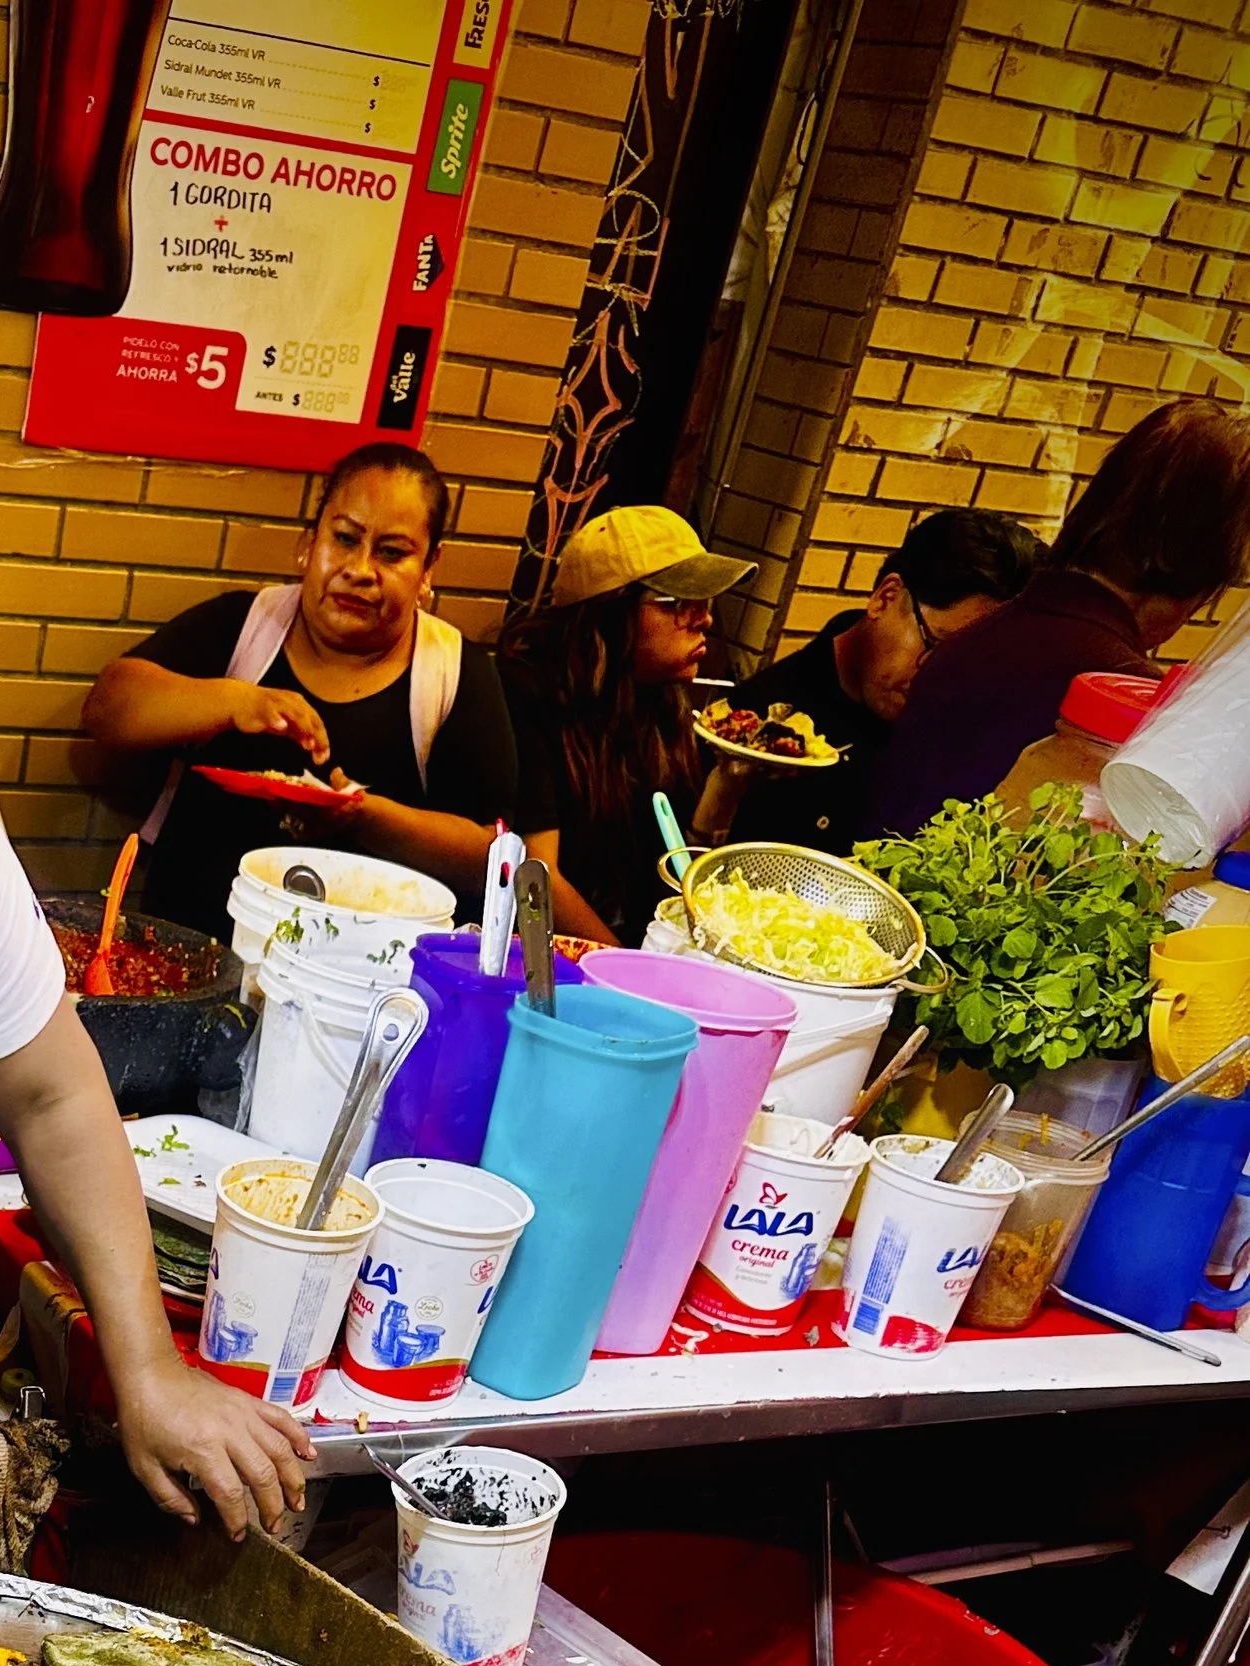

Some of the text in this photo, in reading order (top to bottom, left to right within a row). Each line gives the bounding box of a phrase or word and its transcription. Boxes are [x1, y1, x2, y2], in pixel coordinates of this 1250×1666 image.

[465, 0, 490, 49] FRES
[167, 34, 217, 53] Coca-Cola
[218, 43, 250, 59] 355ml
[251, 50, 265, 62] VR
[164, 59, 193, 75] Sidral
[195, 65, 232, 81] Mundet
[235, 72, 265, 87] 355ml
[267, 78, 280, 89] VR
[161, 85, 184, 99] Valle
[186, 89, 207, 102] Frut
[208, 92, 239, 107] 355ml
[241, 98, 255, 110] VR
[440, 103, 469, 179] Sprite
[150, 137, 396, 201] COMBO AHORRO
[170, 181, 271, 213] 1 GORDITA
[160, 237, 293, 264] 1 SIDRAL 355ml
[167, 262, 203, 273] vidrio
[121, 349, 172, 363] REFRESCO
[159, 340, 180, 351] CON
[116, 364, 178, 383] AHORRA
[184, 345, 229, 389] $5
[393, 352, 416, 403] Valle
[255, 391, 283, 402] ANTES
[724, 1204, 813, 1236] LALA
[731, 1239, 789, 1260] crema
[739, 1254, 775, 1268] original
[936, 1241, 989, 1273] LA
[351, 1287, 375, 1314] ema
